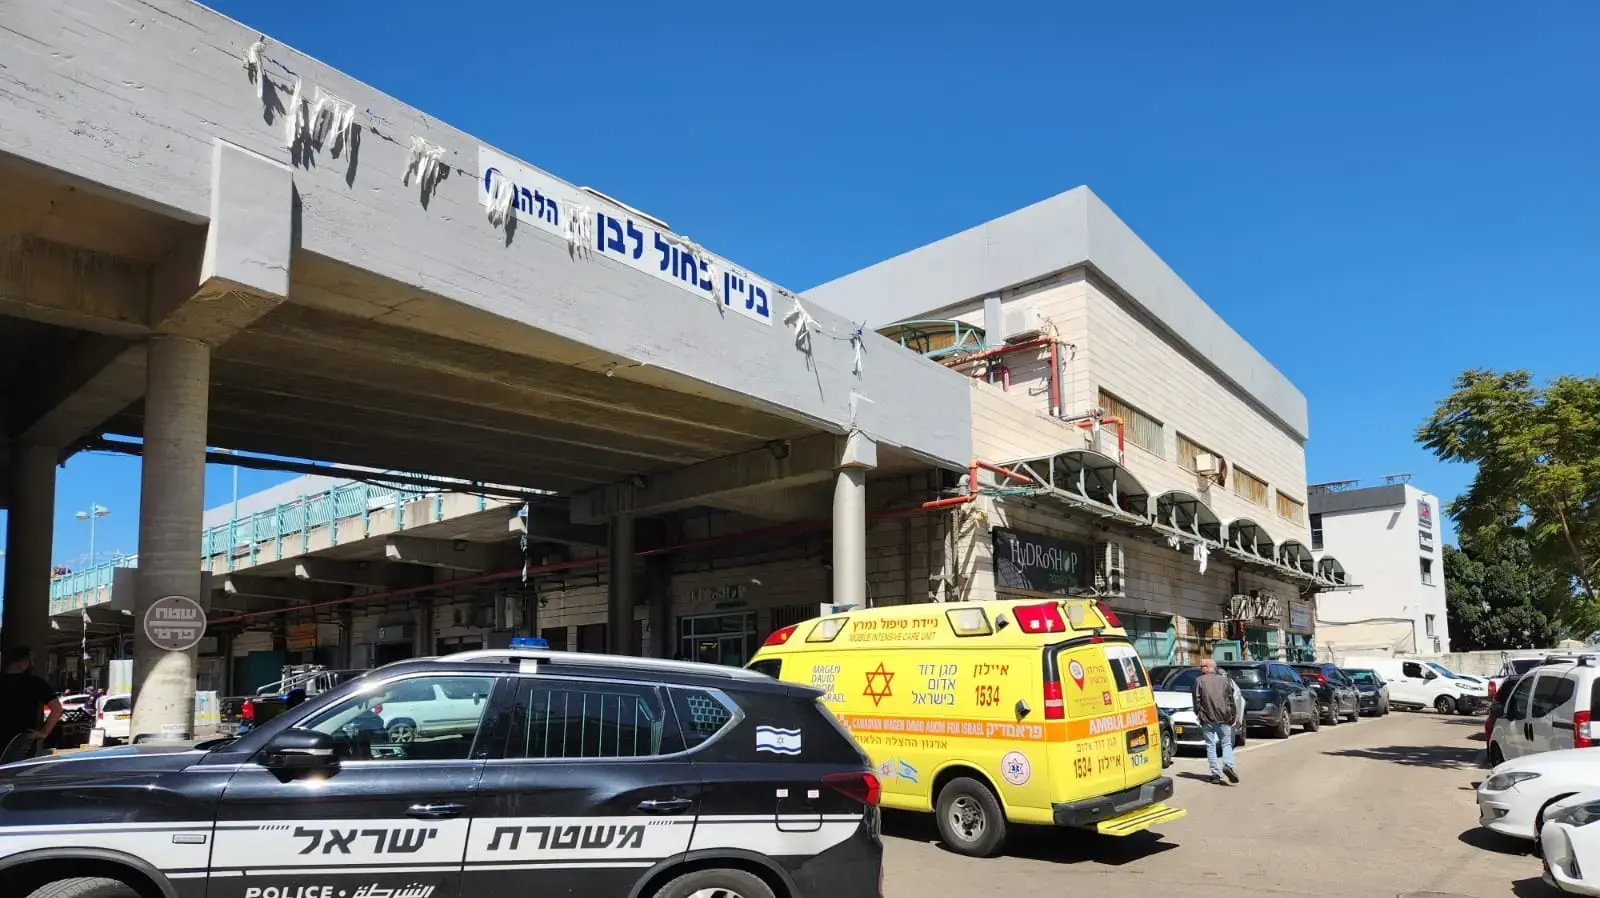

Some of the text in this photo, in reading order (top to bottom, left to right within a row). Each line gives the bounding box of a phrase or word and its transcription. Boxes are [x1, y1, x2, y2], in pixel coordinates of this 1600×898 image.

[597, 212, 644, 260] לבן
[723, 272, 770, 318] בניין
[155, 607, 197, 620] שטח
[853, 617, 939, 632] ניידת טיפול נמרץ
[153, 628, 195, 640] פרטי
[849, 631, 936, 642] MOBILE INTENSIVE CARE UNIT
[813, 664, 841, 674] MAGEN
[918, 664, 958, 678] מגן דוד
[973, 662, 1010, 678] איילון
[811, 674, 835, 684] DAVID
[928, 678, 956, 690] אדום
[821, 692, 847, 702] SRAEL
[911, 690, 955, 705] בישראל
[975, 685, 1000, 707] 1534
[883, 718, 905, 731] MAGEN
[906, 719, 925, 733] DAVID
[947, 721, 960, 735] FOR
[961, 721, 984, 736] ISRAEL
[1088, 709, 1148, 735] AMBULANCE
[986, 722, 1043, 739] פראמדיק
[853, 734, 882, 745] הלאומ
[885, 736, 918, 748] ההצלה
[1074, 757, 1092, 778] 1534
[1098, 754, 1121, 774] איילון
[293, 825, 646, 855] משטרת ישראל
[245, 885, 334, 898] POLICE
